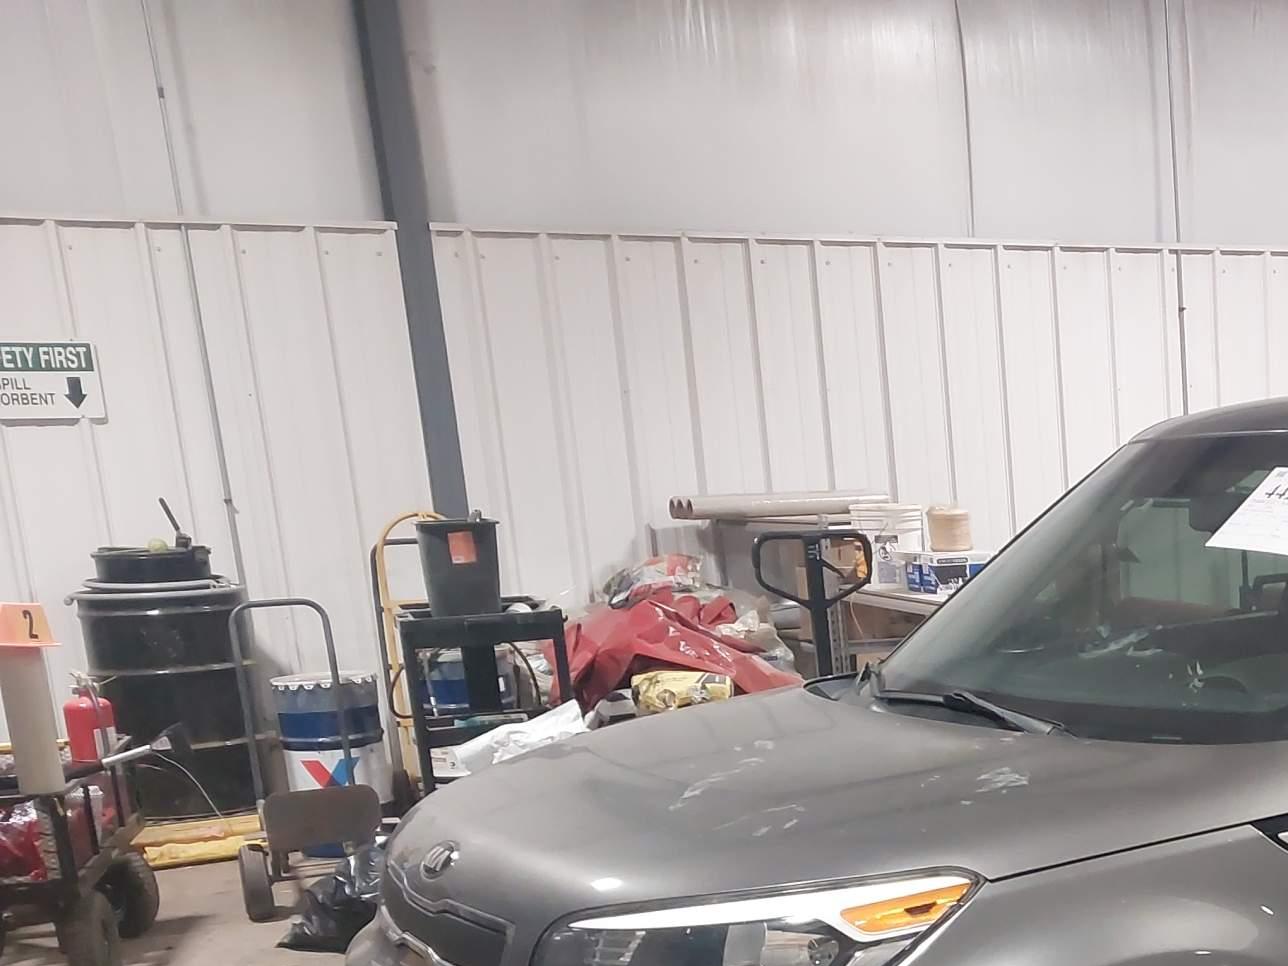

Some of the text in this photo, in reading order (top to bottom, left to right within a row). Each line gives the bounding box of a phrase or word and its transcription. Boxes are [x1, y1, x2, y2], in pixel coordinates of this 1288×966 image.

[39, 347, 87, 368] FIRST
[0, 377, 31, 390] PILL
[22, 609, 39, 639] 2
